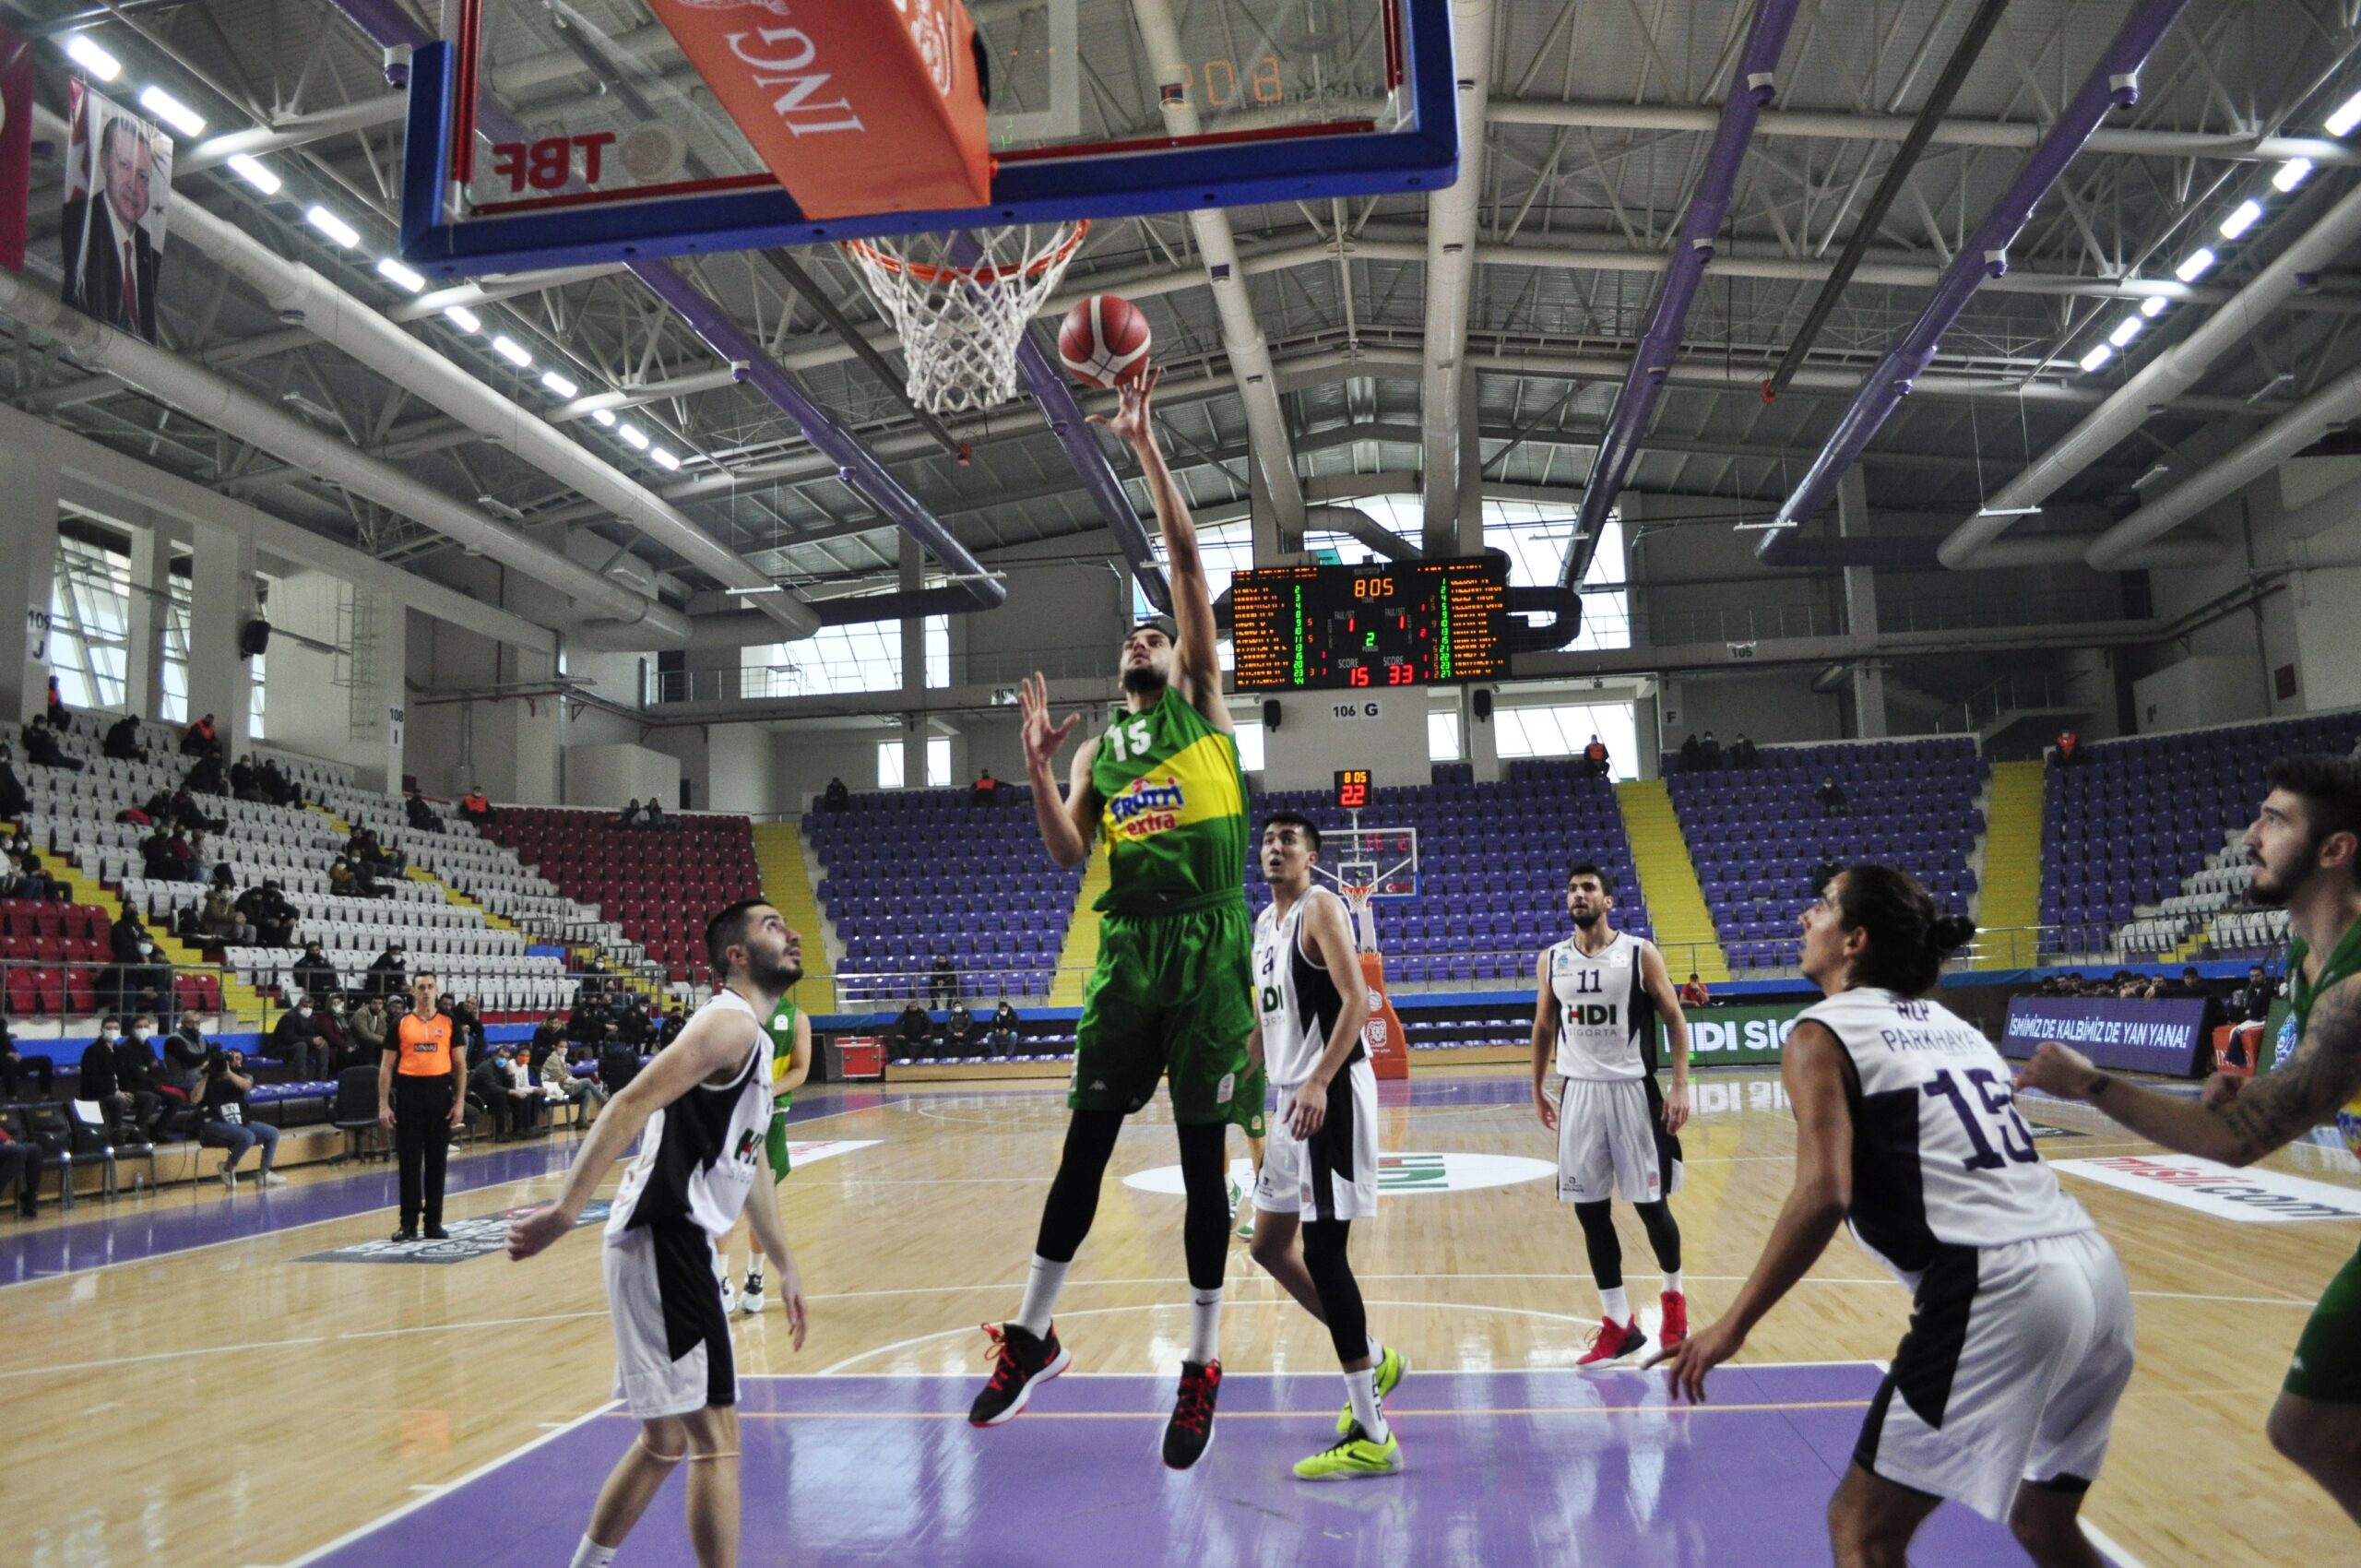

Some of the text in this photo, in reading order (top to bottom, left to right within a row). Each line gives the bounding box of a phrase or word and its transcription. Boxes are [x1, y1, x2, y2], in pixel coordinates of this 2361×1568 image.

[725, 27, 865, 137] ING
[29, 610, 51, 631] 109
[1366, 632, 1374, 646] 2
[33, 640, 44, 659] J
[1731, 647, 1752, 658] 105
[1338, 658, 1358, 669] SCORE
[1383, 656, 1404, 666] SCORE
[1351, 666, 1369, 686] 15
[1389, 664, 1414, 685] 33
[389, 708, 404, 722] 108
[1333, 703, 1378, 718] 106 G
[1667, 711, 1677, 723] F
[1108, 719, 1151, 762] 15
[1341, 785, 1365, 805] 22
[1127, 814, 1176, 836] extra
[1576, 969, 1603, 993] 11
[1261, 985, 1284, 1013] DI
[1568, 1004, 1618, 1026] HDI
[2056, 1016, 2105, 1042] KALBİMİZ
[2123, 1022, 2147, 1046] YAN
[2149, 1024, 2190, 1049] YANA!
[1923, 1068, 2039, 1171] 15
